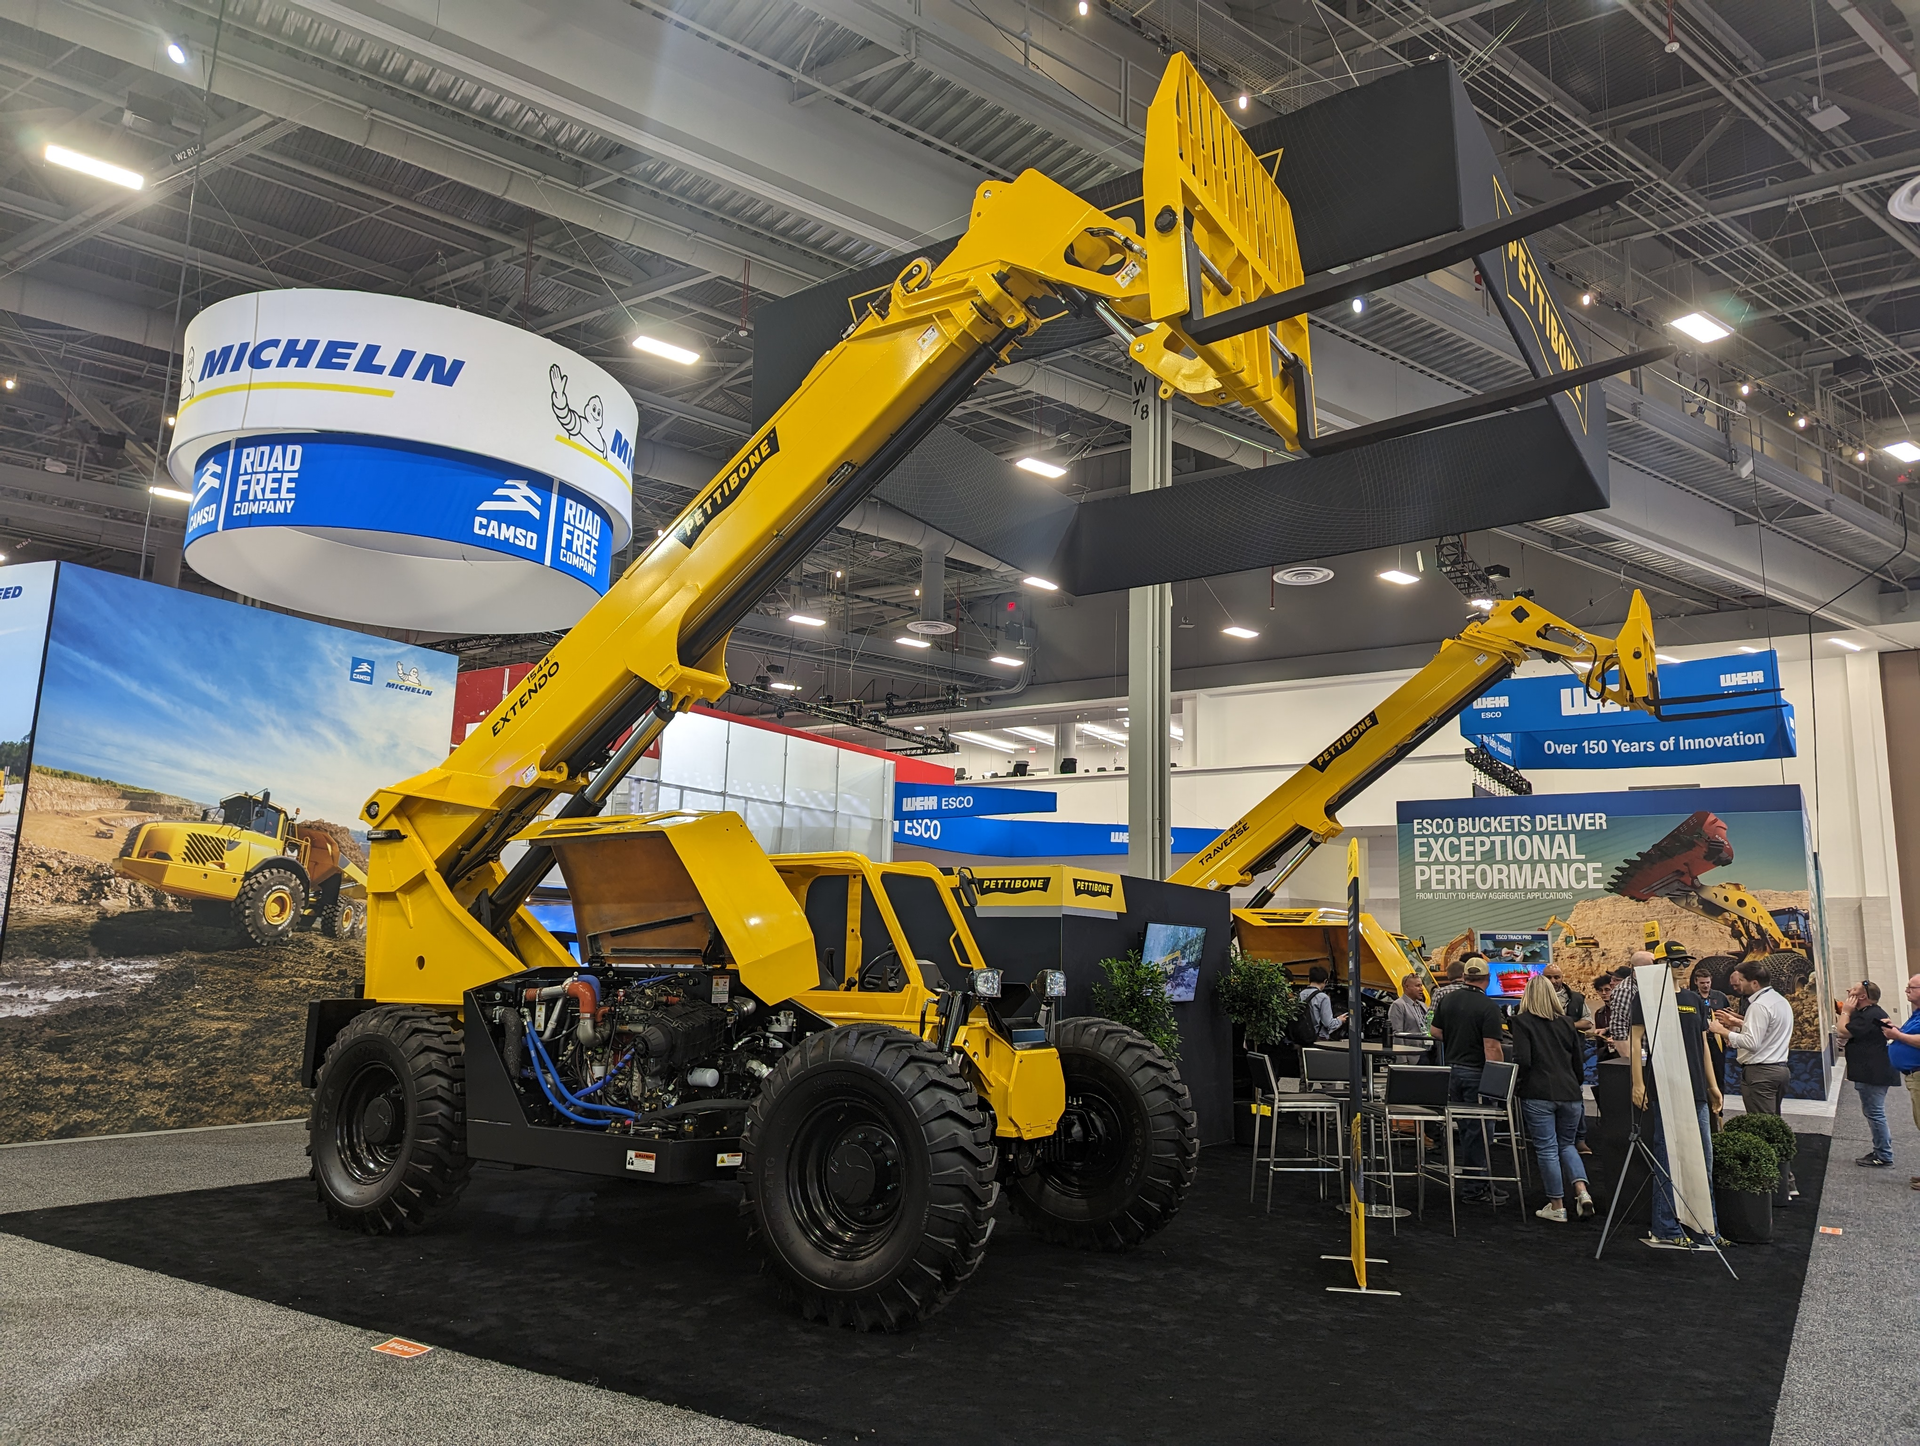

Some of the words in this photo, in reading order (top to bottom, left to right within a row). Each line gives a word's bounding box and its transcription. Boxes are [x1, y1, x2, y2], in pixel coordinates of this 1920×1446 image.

[197, 338, 466, 388] MICHELIN
[1133, 376, 1148, 396] W
[239, 444, 303, 474] ROAD
[235, 472, 299, 501] FREE
[684, 439, 771, 537] PETTIBONE
[188, 503, 217, 533] CAMSO
[233, 500, 295, 516] COMPANY
[564, 497, 601, 540] ROAD
[473, 515, 538, 551] CAMSO
[561, 522, 599, 565] FREE
[559, 548, 597, 578] COMPANY
[385, 681, 433, 697] MICHELIN
[491, 661, 560, 737] EXTENDO
[1481, 711, 1502, 719] ESCO
[1316, 716, 1373, 766] PETTIBONE
[1544, 740, 1578, 754] Over
[1582, 739, 1608, 754] 150
[1611, 738, 1655, 753] Years
[1659, 737, 1675, 751] of
[1679, 731, 1765, 750] Innovation
[941, 796, 974, 810] ESCO
[904, 818, 941, 841] ESCO
[1413, 818, 1453, 835] ESCO
[1458, 815, 1532, 834] BUCKETS
[1535, 813, 1607, 832] DELIVER
[1198, 822, 1250, 866] TRAVERSE
[1414, 833, 1586, 863] EXCEPTIONAL
[983, 879, 1045, 889] PETTIBONE
[1076, 880, 1111, 894] PETTIBONE
[1415, 862, 1604, 890] PERFORMANCE
[1416, 892, 1433, 900] FROM
[1434, 892, 1457, 900] UTILITY
[1457, 892, 1466, 900] TO
[1467, 892, 1488, 900] HEAVY
[1526, 891, 1573, 899] APPLICATIONS
